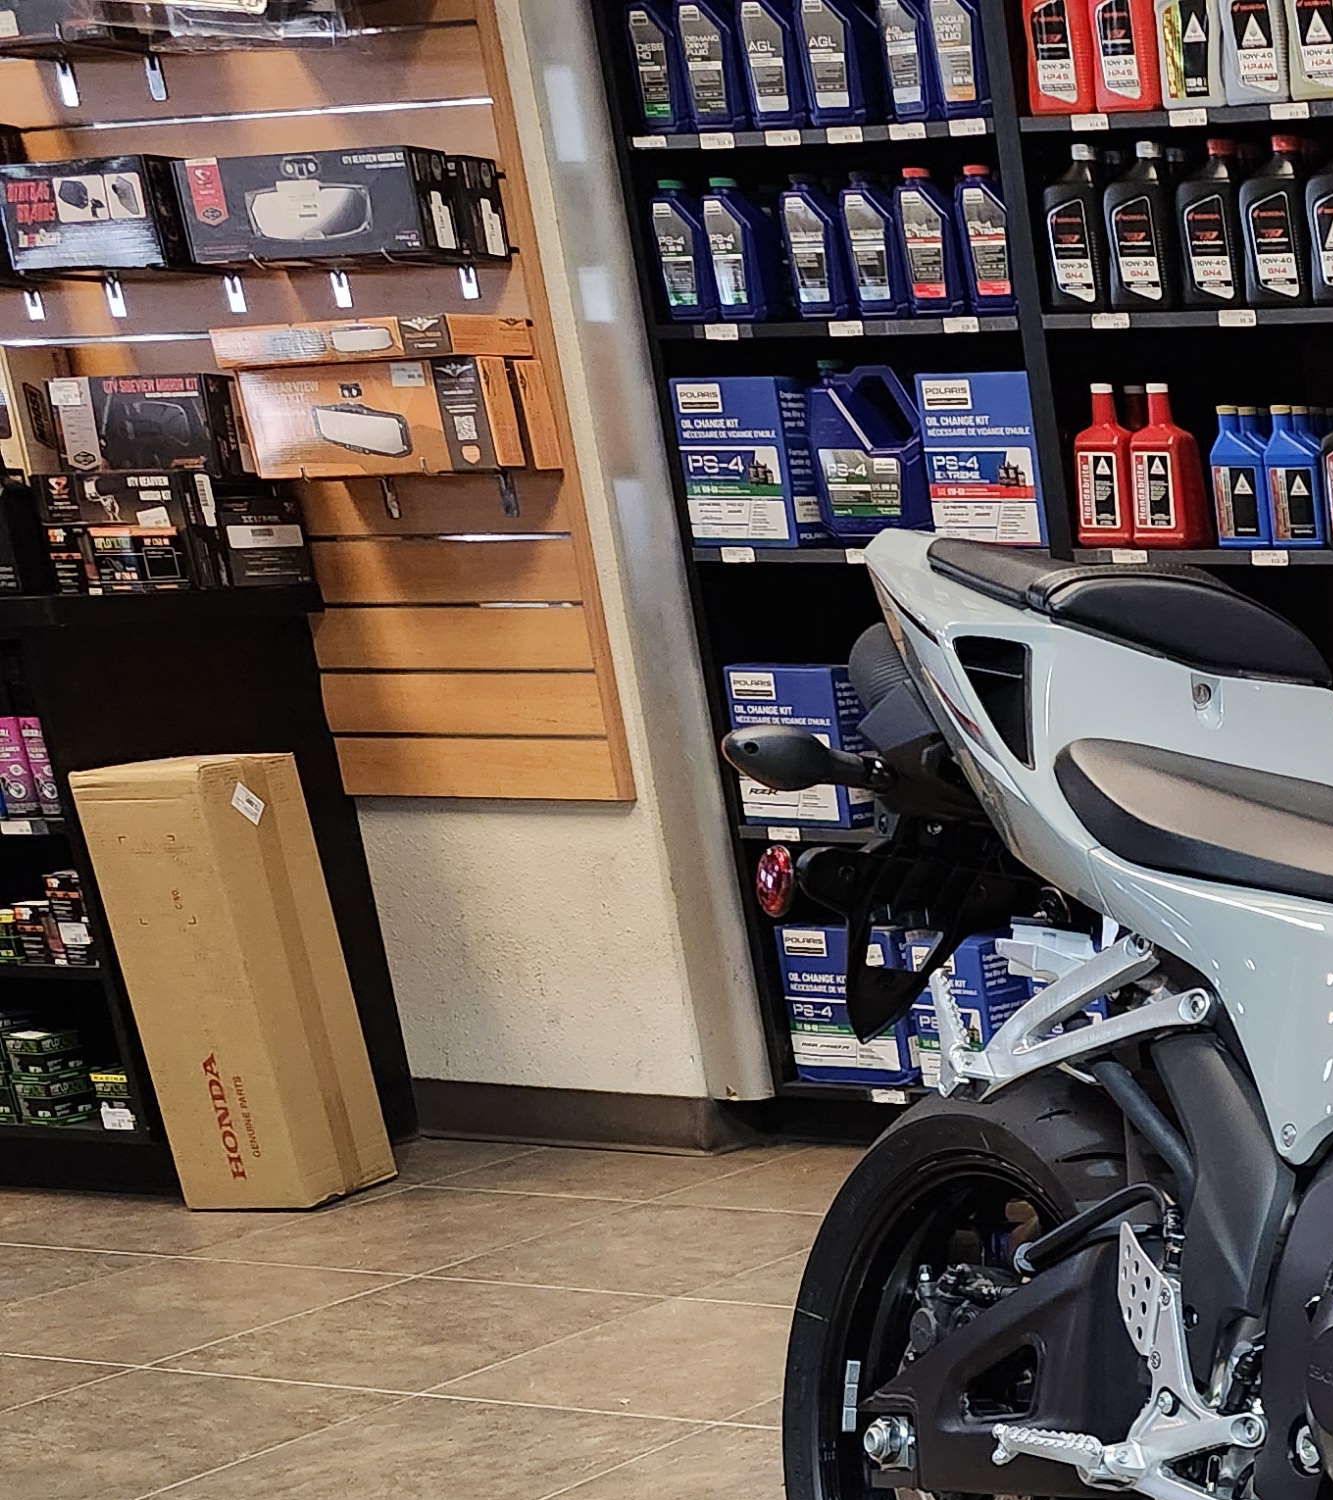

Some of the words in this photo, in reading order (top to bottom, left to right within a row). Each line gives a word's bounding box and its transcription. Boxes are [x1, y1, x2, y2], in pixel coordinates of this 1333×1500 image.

[748, 41, 776, 53] AGL
[809, 36, 837, 48] AGL
[1241, 52, 1273, 62] 10W-40
[1040, 61, 1071, 71] 10W-30
[1105, 58, 1134, 68] 10W-30
[1243, 62, 1274, 72] HP4M
[1310, 59, 1332, 68] HP4
[1042, 72, 1069, 81] HP4S
[1108, 69, 1134, 78] HP4S
[1123, 259, 1155, 269] 10W-30
[1196, 258, 1228, 268] 10W-40
[1261, 255, 1293, 265] 10W-40
[1059, 261, 1089, 270] 10W-30
[1267, 266, 1288, 275] GN4
[1065, 271, 1084, 280] GN4
[1130, 269, 1150, 278] GN4
[1202, 268, 1222, 277] GN4
[678, 389, 720, 400] POLARIS
[924, 386, 968, 396] POLARIS
[681, 418, 697, 430] OIL
[699, 418, 725, 429] CHANGE
[726, 417, 739, 429] KIT
[925, 416, 940, 427] OIL
[941, 415, 974, 427] CHANGE
[975, 414, 989, 426] KIT
[687, 454, 745, 473] PS-4
[932, 456, 979, 471] PS-4
[826, 462, 867, 478] PS-4
[731, 677, 773, 688] POLARIS
[733, 705, 747, 716] OIL
[748, 705, 778, 716] CHANGE
[779, 705, 793, 716] KIT
[784, 935, 826, 947] POLARIS
[788, 972, 801, 983] OIL
[802, 972, 832, 983] CHANGE
[792, 1003, 833, 1018] PS-4
[232, 1075, 249, 1109] PARTS
[202, 1052, 247, 1181] HONDA
[242, 1112, 261, 1158] GENUINE
